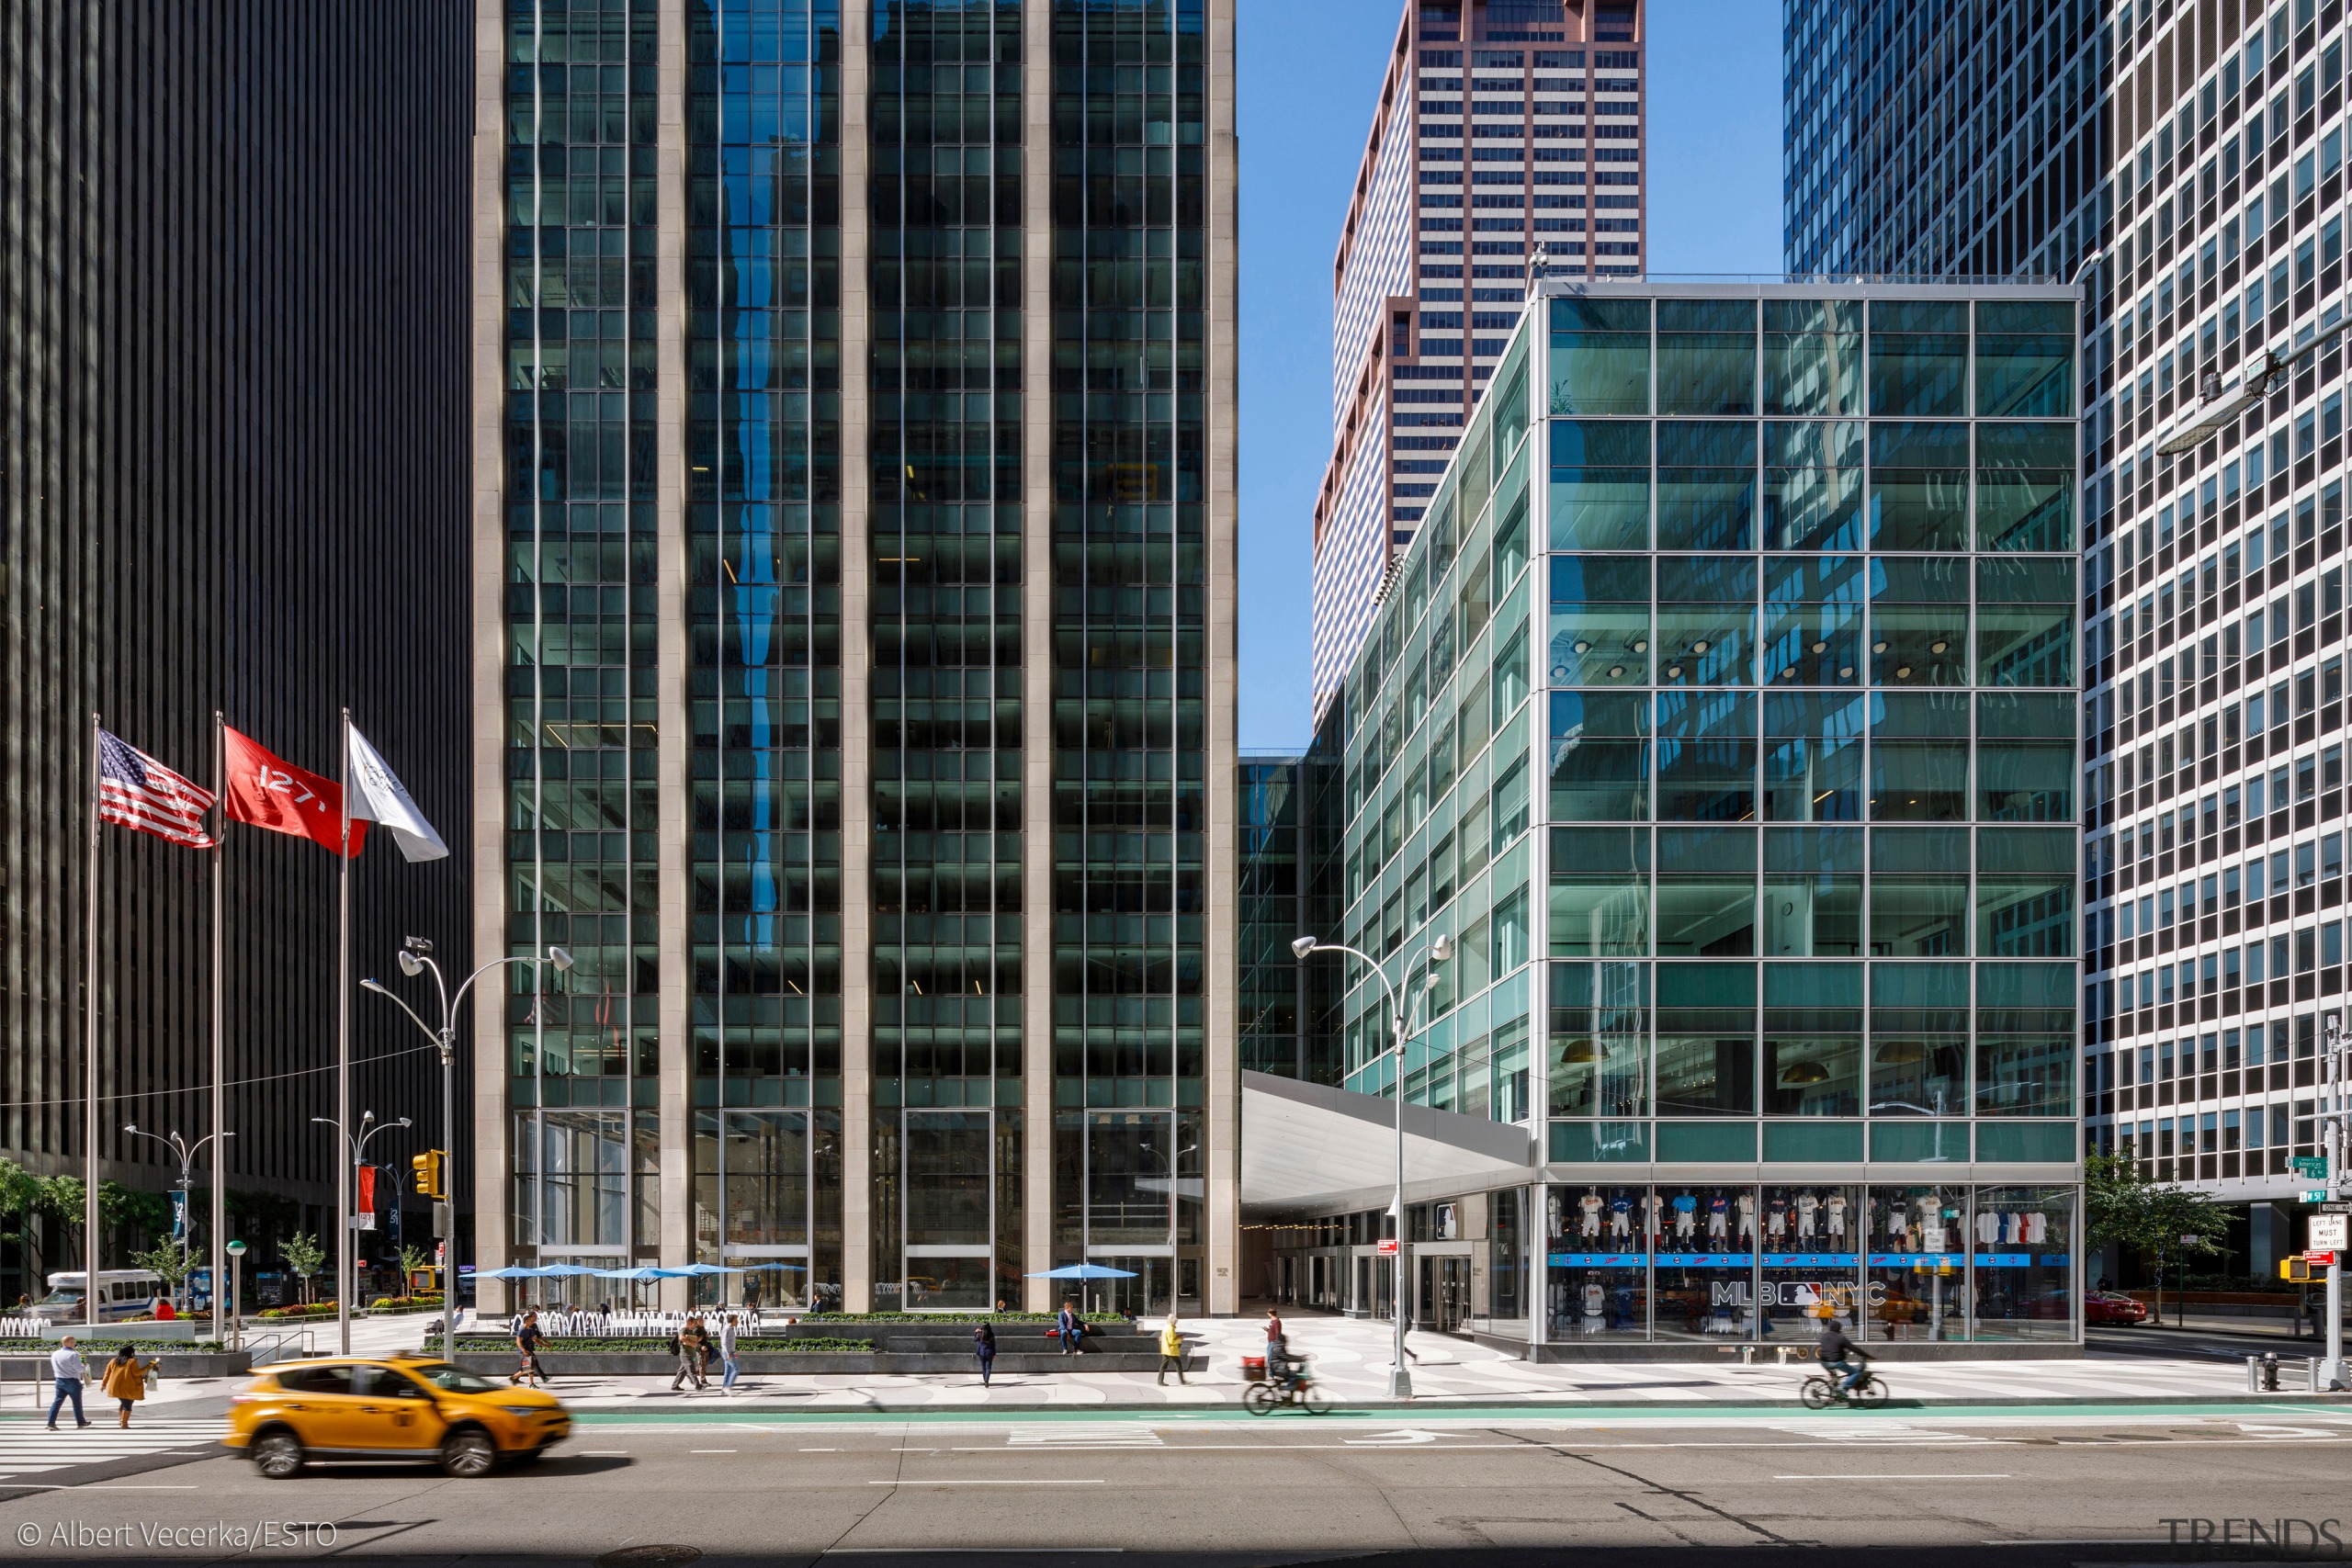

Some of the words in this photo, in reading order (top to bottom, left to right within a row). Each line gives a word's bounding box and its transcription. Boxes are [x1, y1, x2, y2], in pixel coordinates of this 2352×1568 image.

[2311, 1169, 2315, 1178] 6
[2314, 1191, 2321, 1201] 51
[1712, 1281, 1777, 1306] MLB
[1824, 1281, 1886, 1306] NYC
